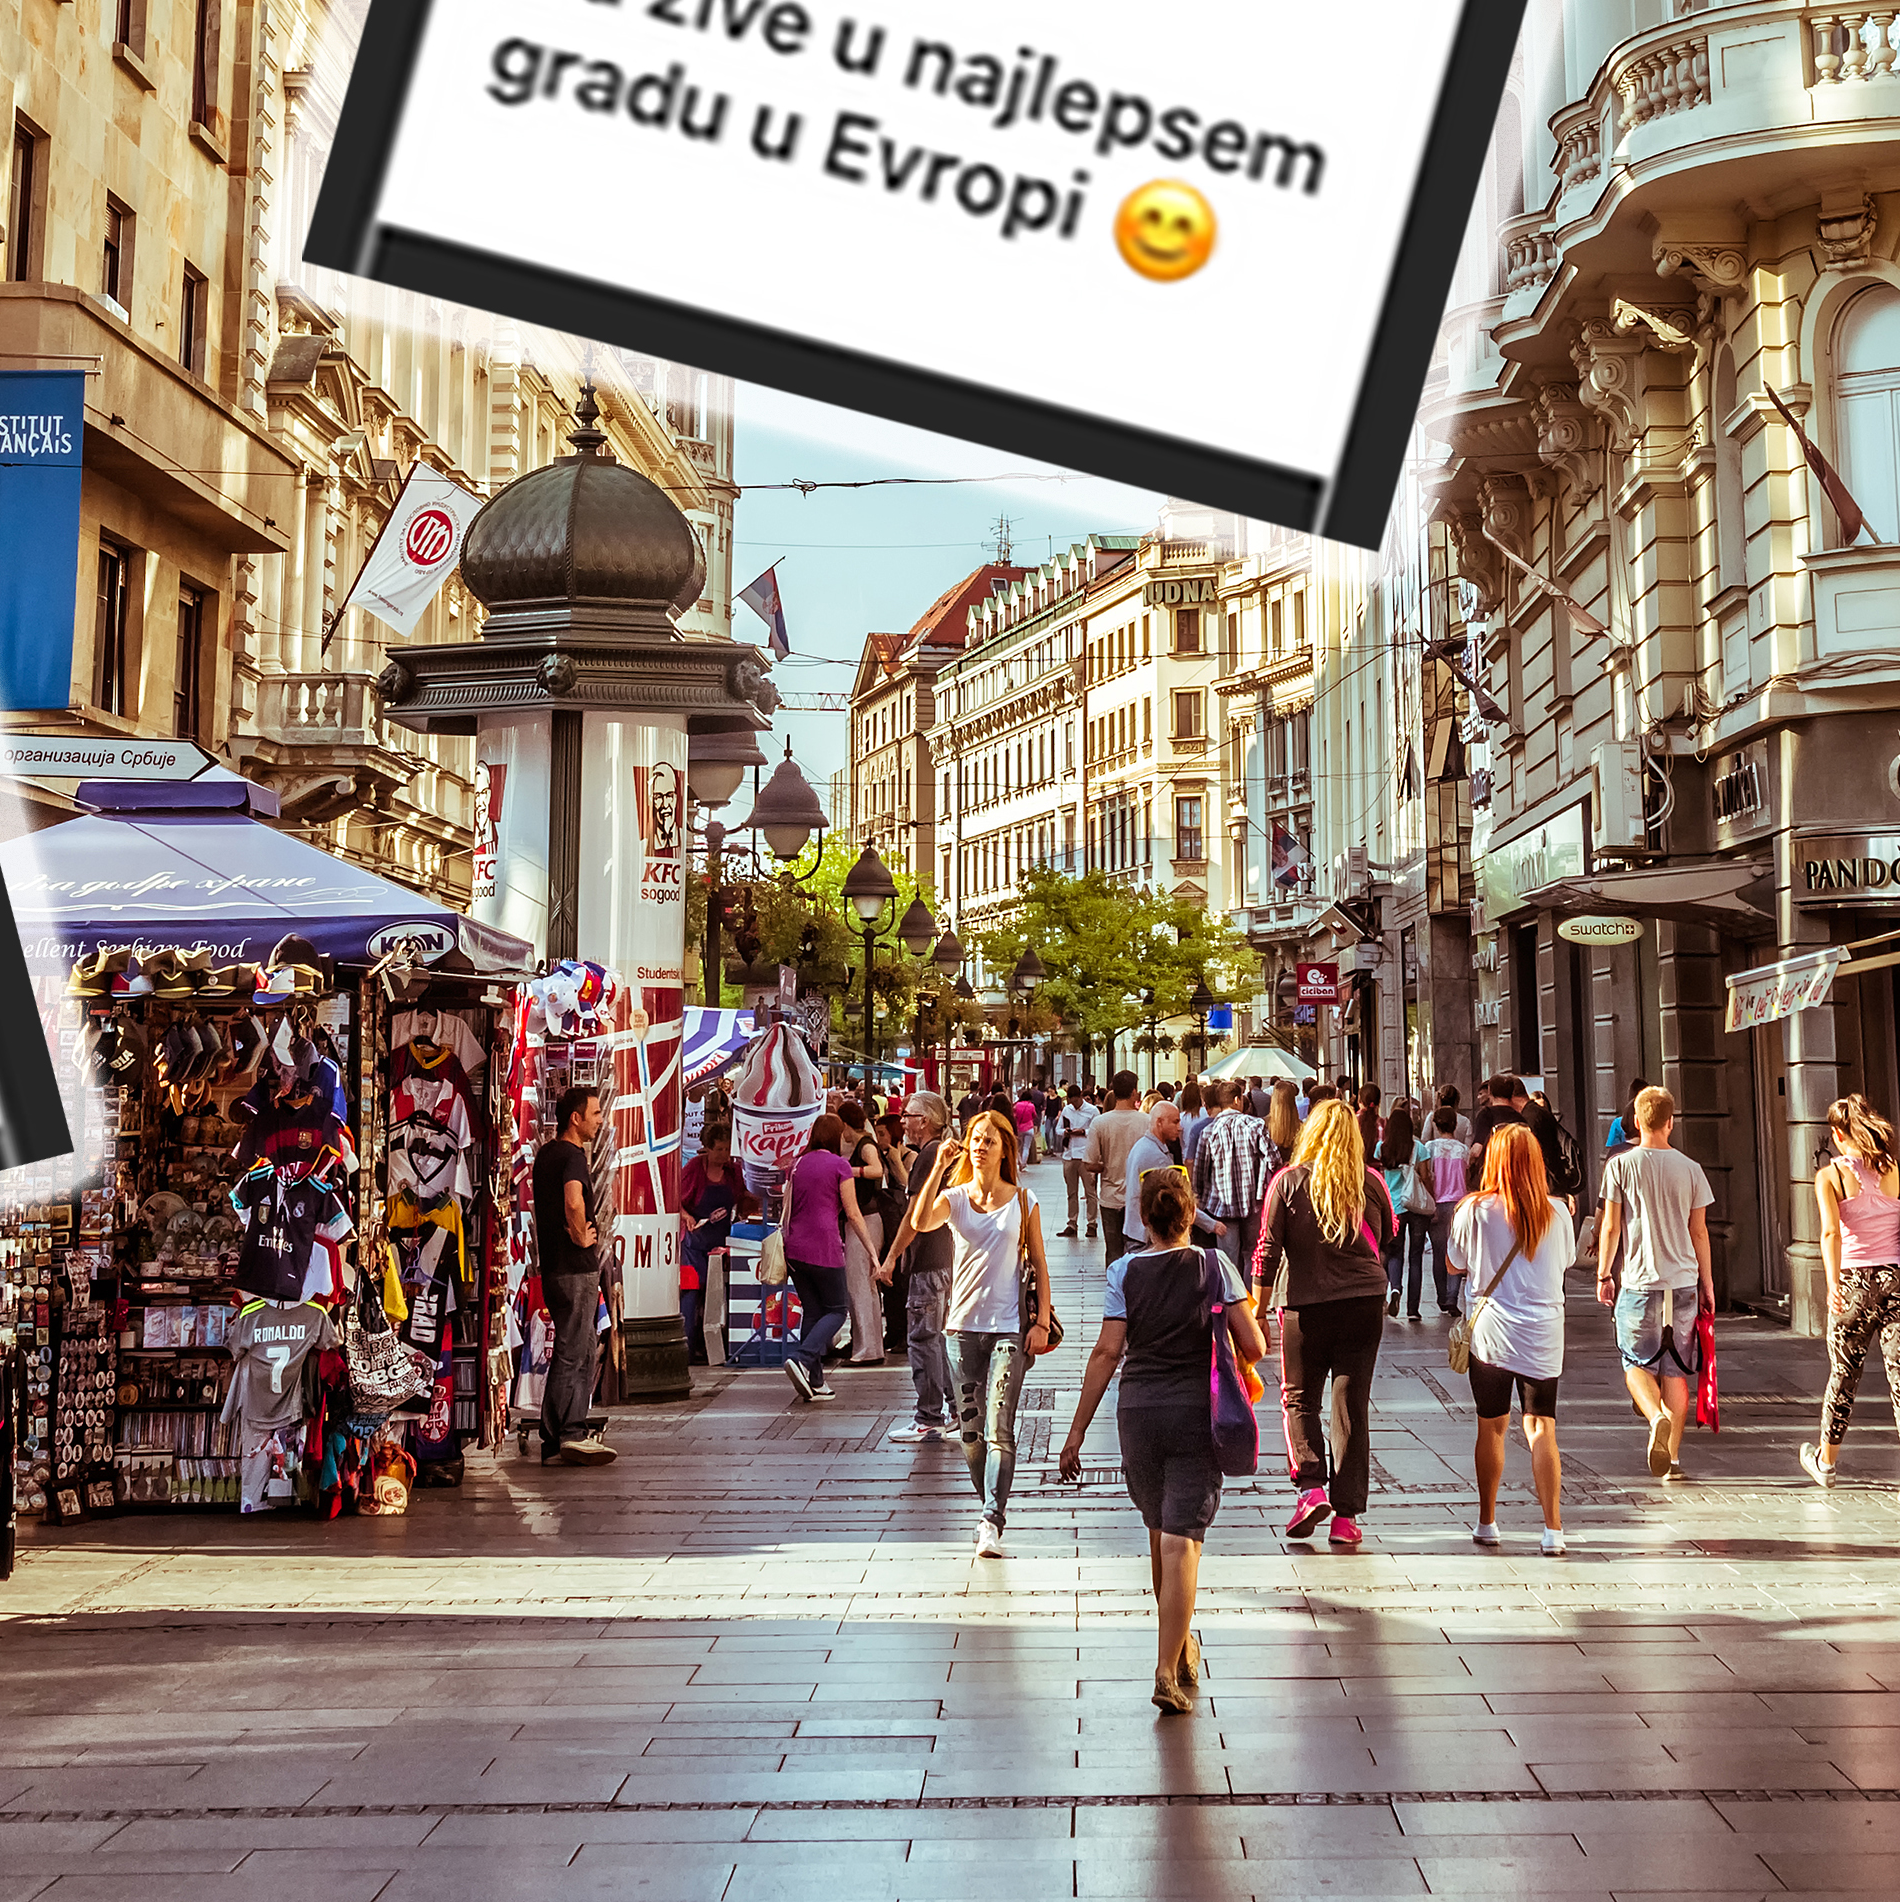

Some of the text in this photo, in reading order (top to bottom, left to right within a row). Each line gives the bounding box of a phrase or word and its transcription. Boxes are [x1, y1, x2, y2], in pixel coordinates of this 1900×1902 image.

[4, 747, 115, 769] организација
[121, 750, 176, 770] Србије
[641, 862, 682, 885] KFC
[1570, 923, 1624, 936] swatch
[1301, 986, 1334, 995] ciciban
[254, 1324, 306, 1344] RONALDO
[266, 1344, 290, 1394] 7
